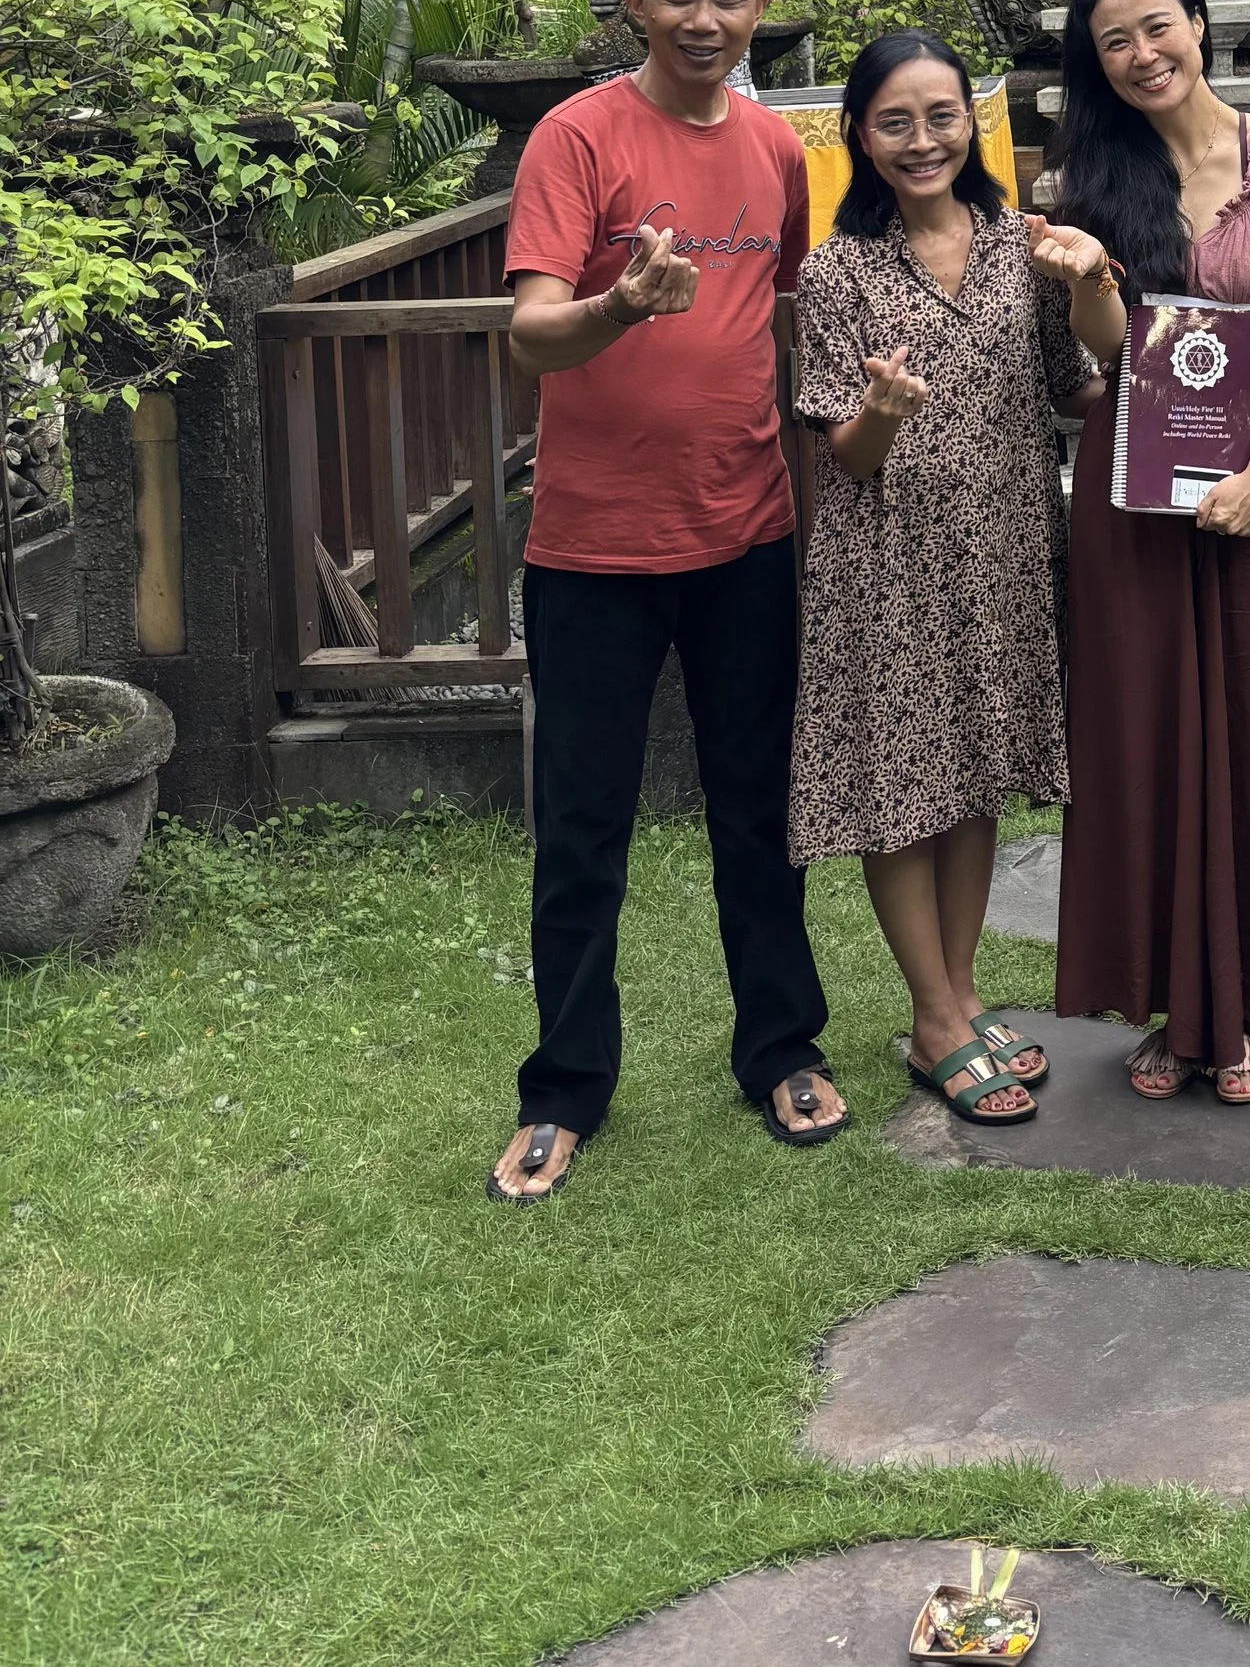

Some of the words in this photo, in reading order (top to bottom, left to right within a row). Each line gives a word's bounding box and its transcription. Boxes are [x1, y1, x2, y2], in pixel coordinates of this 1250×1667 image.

[608, 200, 782, 255] Giordan
[1215, 406, 1224, 414] III
[1167, 413, 1184, 421] Reiki
[1184, 414, 1204, 422] Master
[1205, 415, 1227, 423] Manual
[1162, 430, 1186, 439] Including
